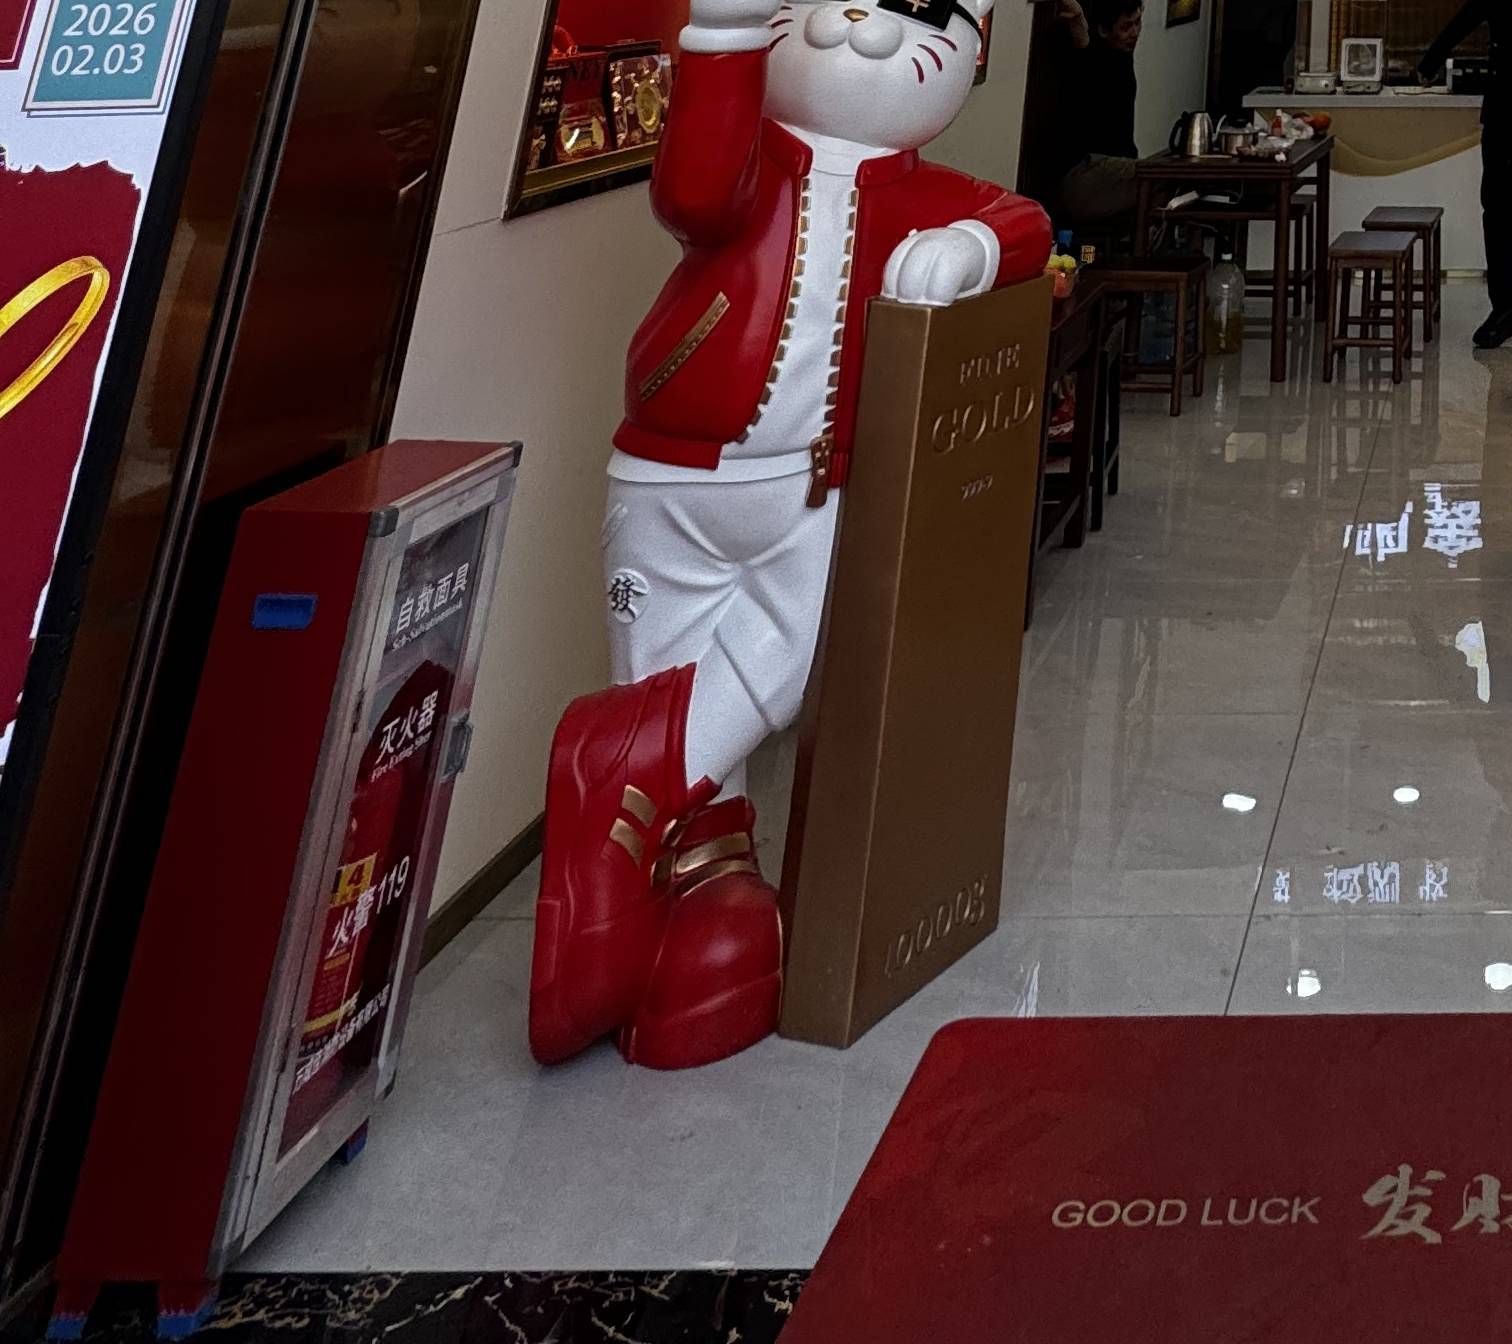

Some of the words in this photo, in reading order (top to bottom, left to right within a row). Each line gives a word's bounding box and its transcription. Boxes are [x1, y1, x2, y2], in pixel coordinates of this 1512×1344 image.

[62, 1, 156, 38] 2026
[50, 42, 145, 78] 02.03
[931, 386, 1035, 455] GOLD
[395, 562, 470, 635] 自救面具
[608, 576, 636, 618] 發
[375, 689, 439, 765] 灭火器
[325, 854, 411, 960] 火警119
[1051, 1197, 1188, 1228] GOOD
[1200, 1195, 1321, 1226] LUCK
